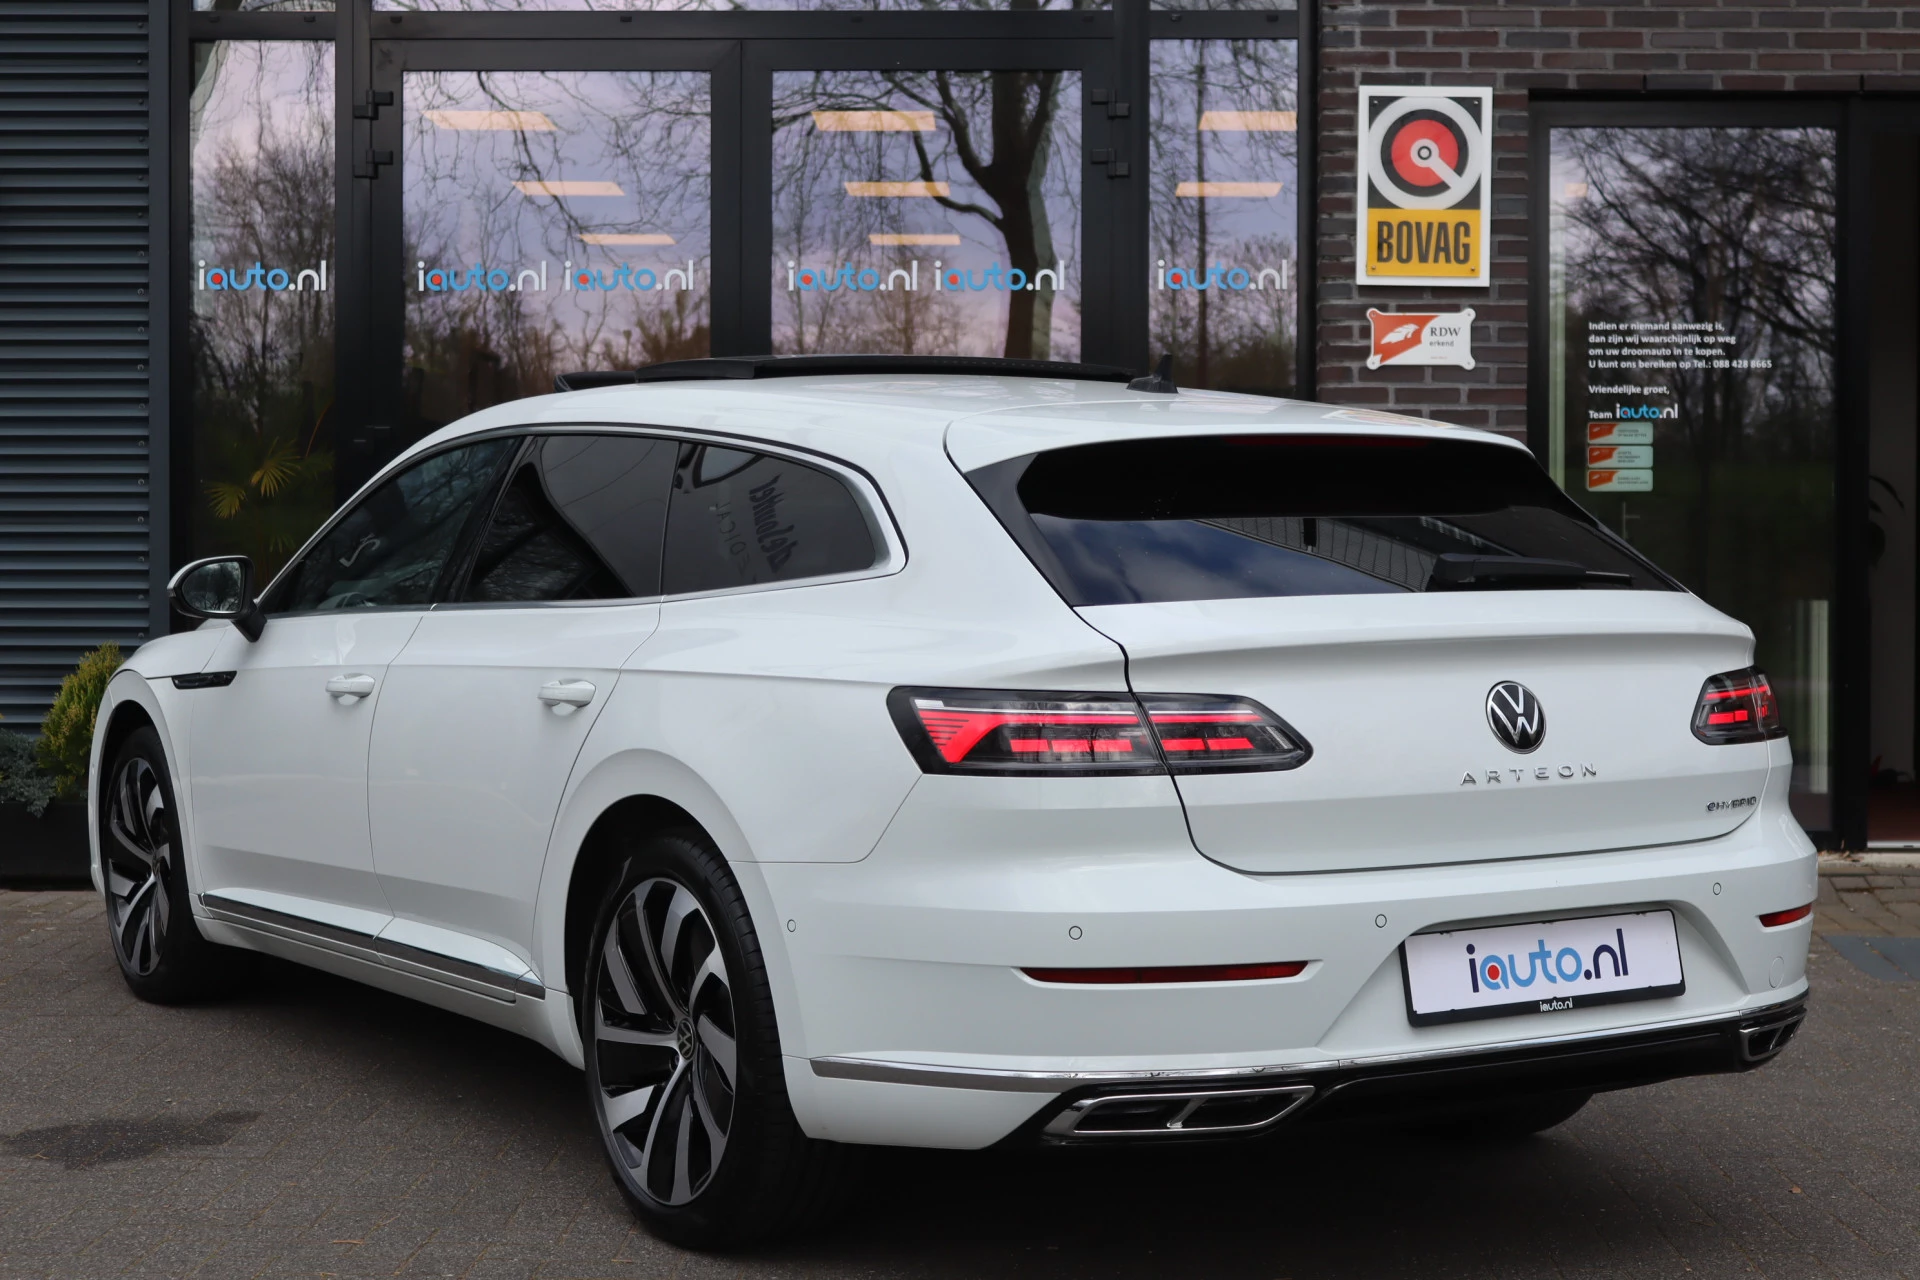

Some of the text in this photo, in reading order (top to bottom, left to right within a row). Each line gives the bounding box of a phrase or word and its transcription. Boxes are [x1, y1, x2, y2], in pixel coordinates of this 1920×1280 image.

[1377, 221, 1471, 264] BOVAG
[198, 259, 327, 291] iauto.nl
[418, 259, 693, 291] iauto.nl iauto.nl
[787, 259, 1065, 291] iauto.nl iauto.nl
[1157, 259, 1288, 291] iauto.nl
[1430, 327, 1461, 337] RDW
[1589, 321, 1725, 332] Indien er niemand aanwezig is,
[1589, 334, 1736, 345] dan zijn wij waarschijnlijk op weg
[1589, 347, 1725, 357] om uw droomauto in te kopen.
[1589, 360, 1596, 368] U
[1598, 360, 1619, 368] kunt
[1638, 359, 1677, 368] bereiken
[1679, 361, 1692, 370] op
[1692, 360, 1711, 368] Tel.:
[1713, 360, 1730, 368] 088
[1732, 360, 1748, 368] 428
[1750, 360, 1772, 368] 8665
[1589, 385, 1670, 395] Vriendelijke groet,
[1589, 403, 1679, 419] Team iauto.nl
[1460, 762, 1597, 786] ARTEON
[1465, 928, 1629, 993] iauto.nl
[1539, 997, 1573, 1012] iauto.nl
